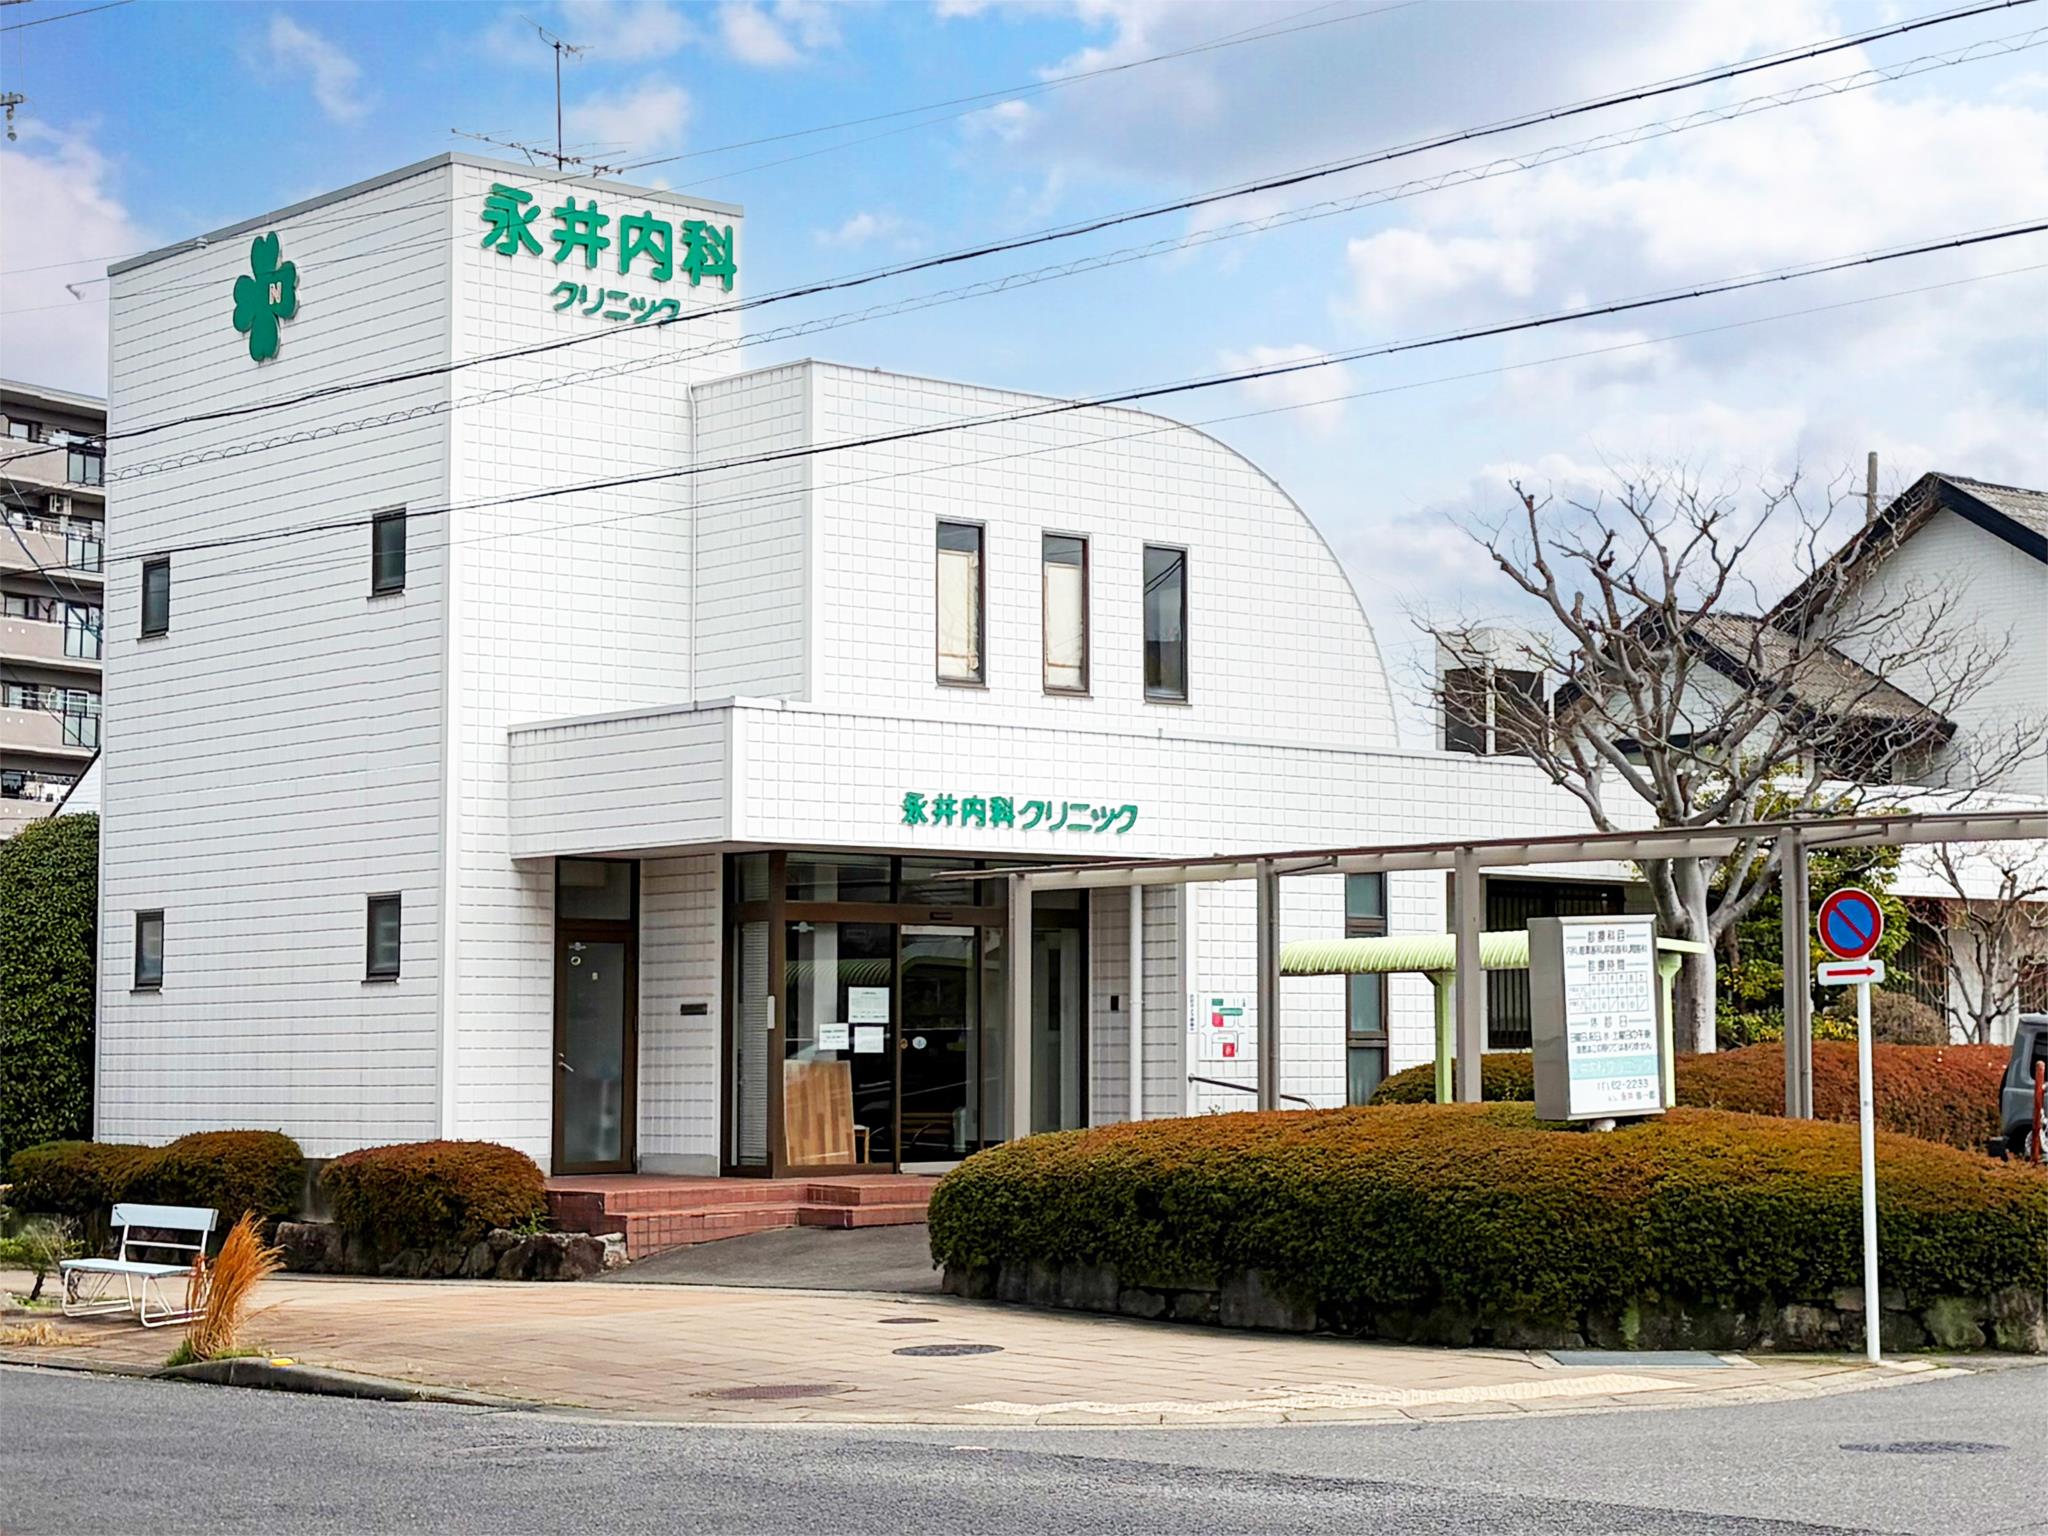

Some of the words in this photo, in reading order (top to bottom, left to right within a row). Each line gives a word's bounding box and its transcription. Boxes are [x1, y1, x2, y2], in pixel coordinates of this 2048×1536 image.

[480, 182, 738, 293] 永井内科
[269, 281, 282, 305] N
[551, 280, 681, 324] クリニック
[901, 791, 1138, 834] 永井内科クリニック
